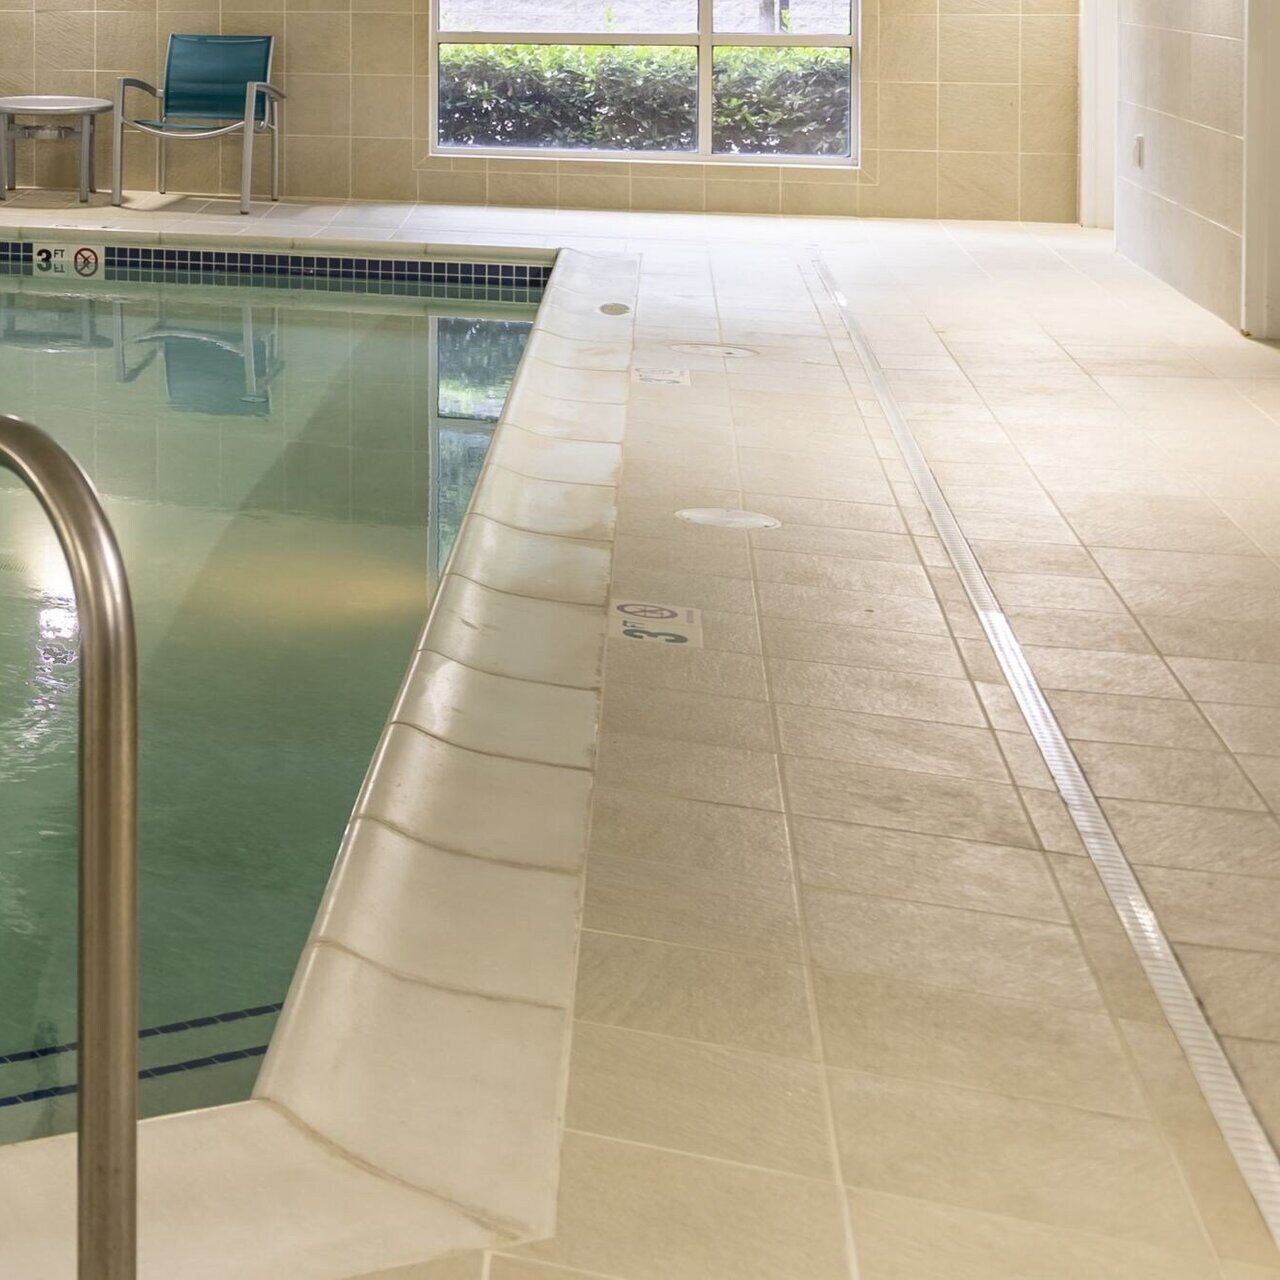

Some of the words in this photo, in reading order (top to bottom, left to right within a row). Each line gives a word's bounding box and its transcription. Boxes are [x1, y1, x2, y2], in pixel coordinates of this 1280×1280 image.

[36, 248, 52, 270] 3
[53, 249, 65, 258] FT
[622, 628, 689, 644] 3
